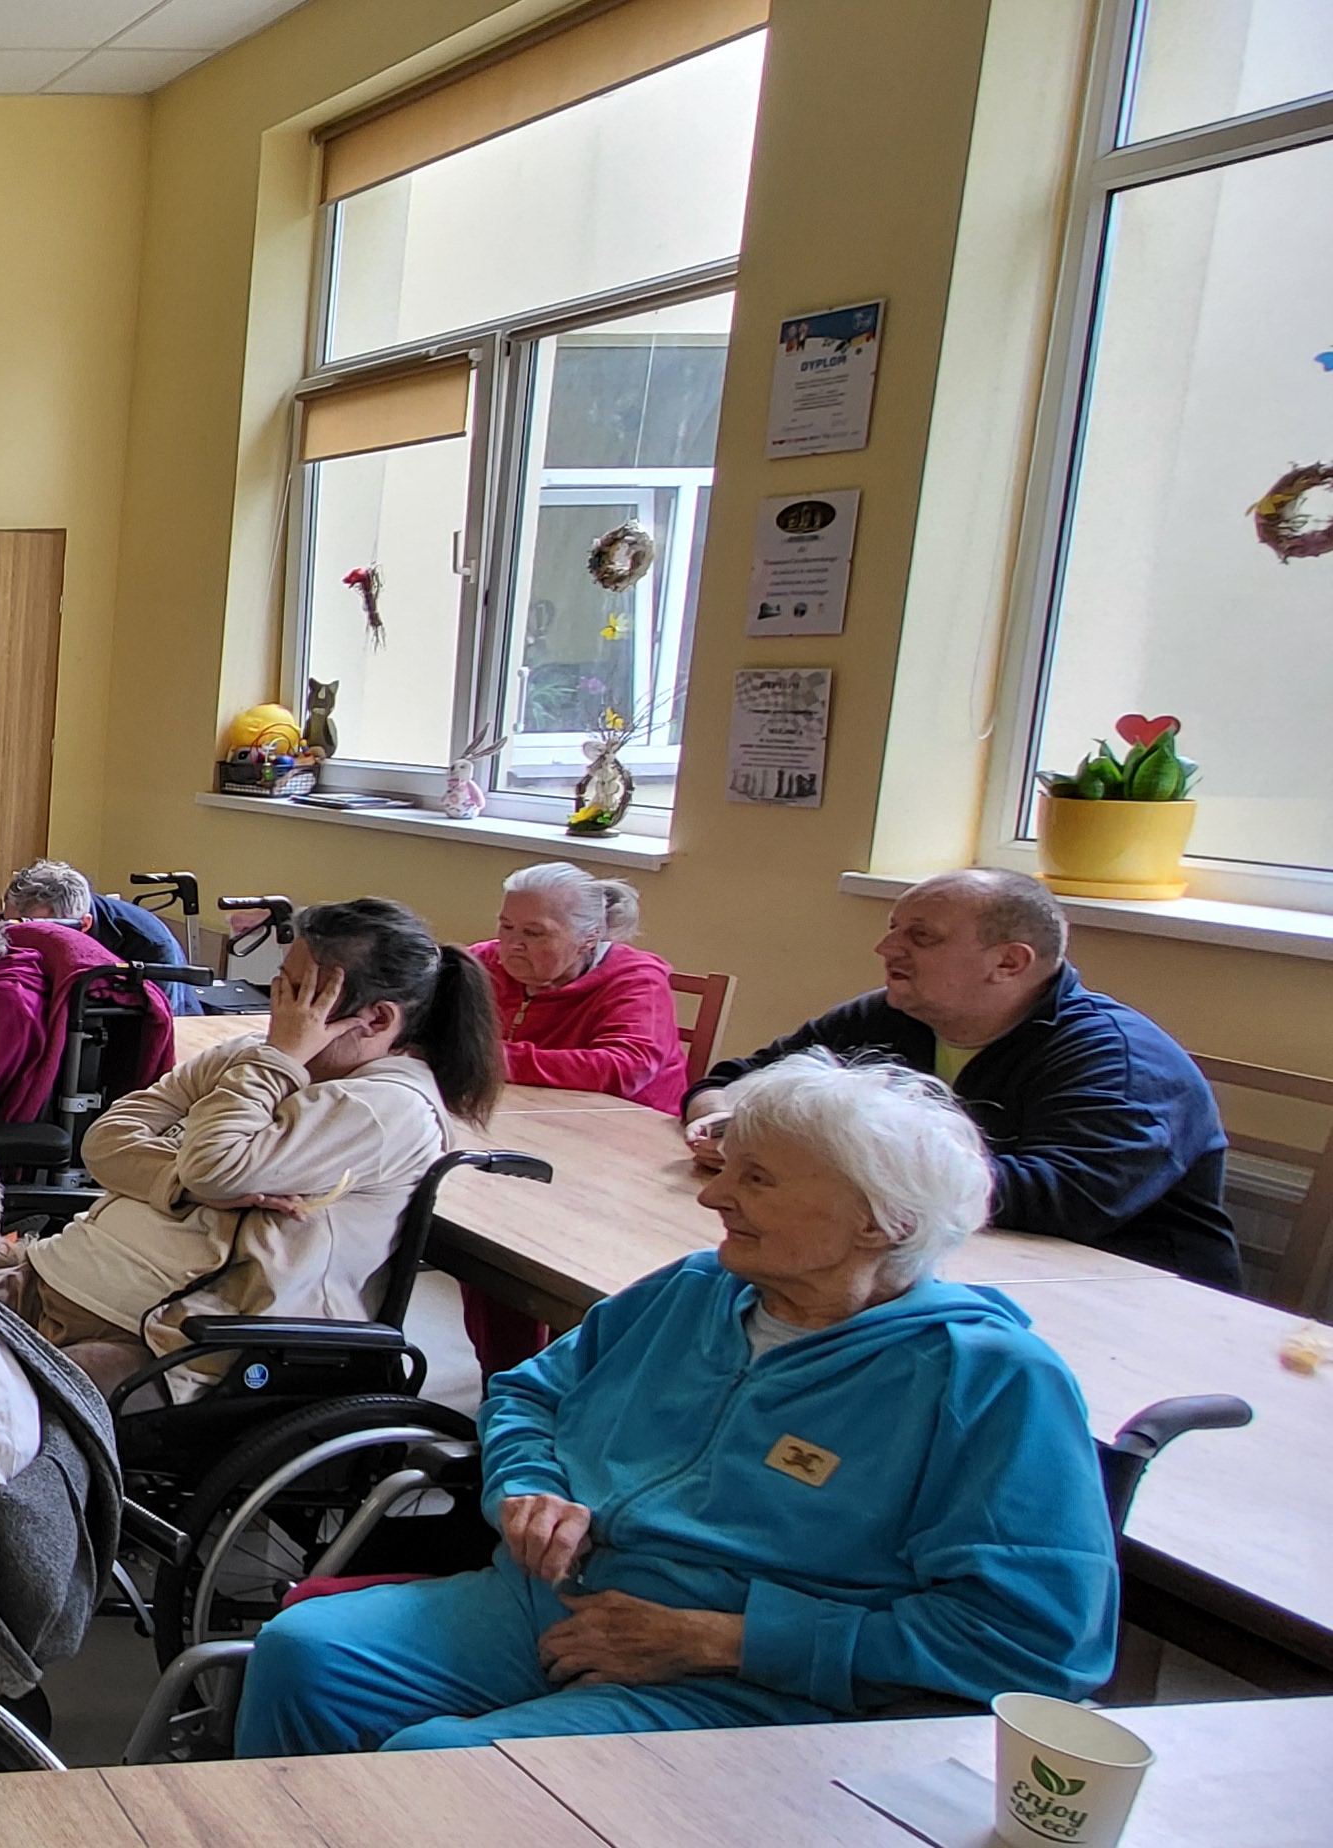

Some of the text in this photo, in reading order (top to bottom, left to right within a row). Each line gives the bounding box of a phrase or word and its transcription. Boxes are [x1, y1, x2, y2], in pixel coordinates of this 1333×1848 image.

[800, 354, 847, 372] DYPLOM
[1013, 1780, 1088, 1829] Enjoy
[1041, 1819, 1079, 1838] eco
